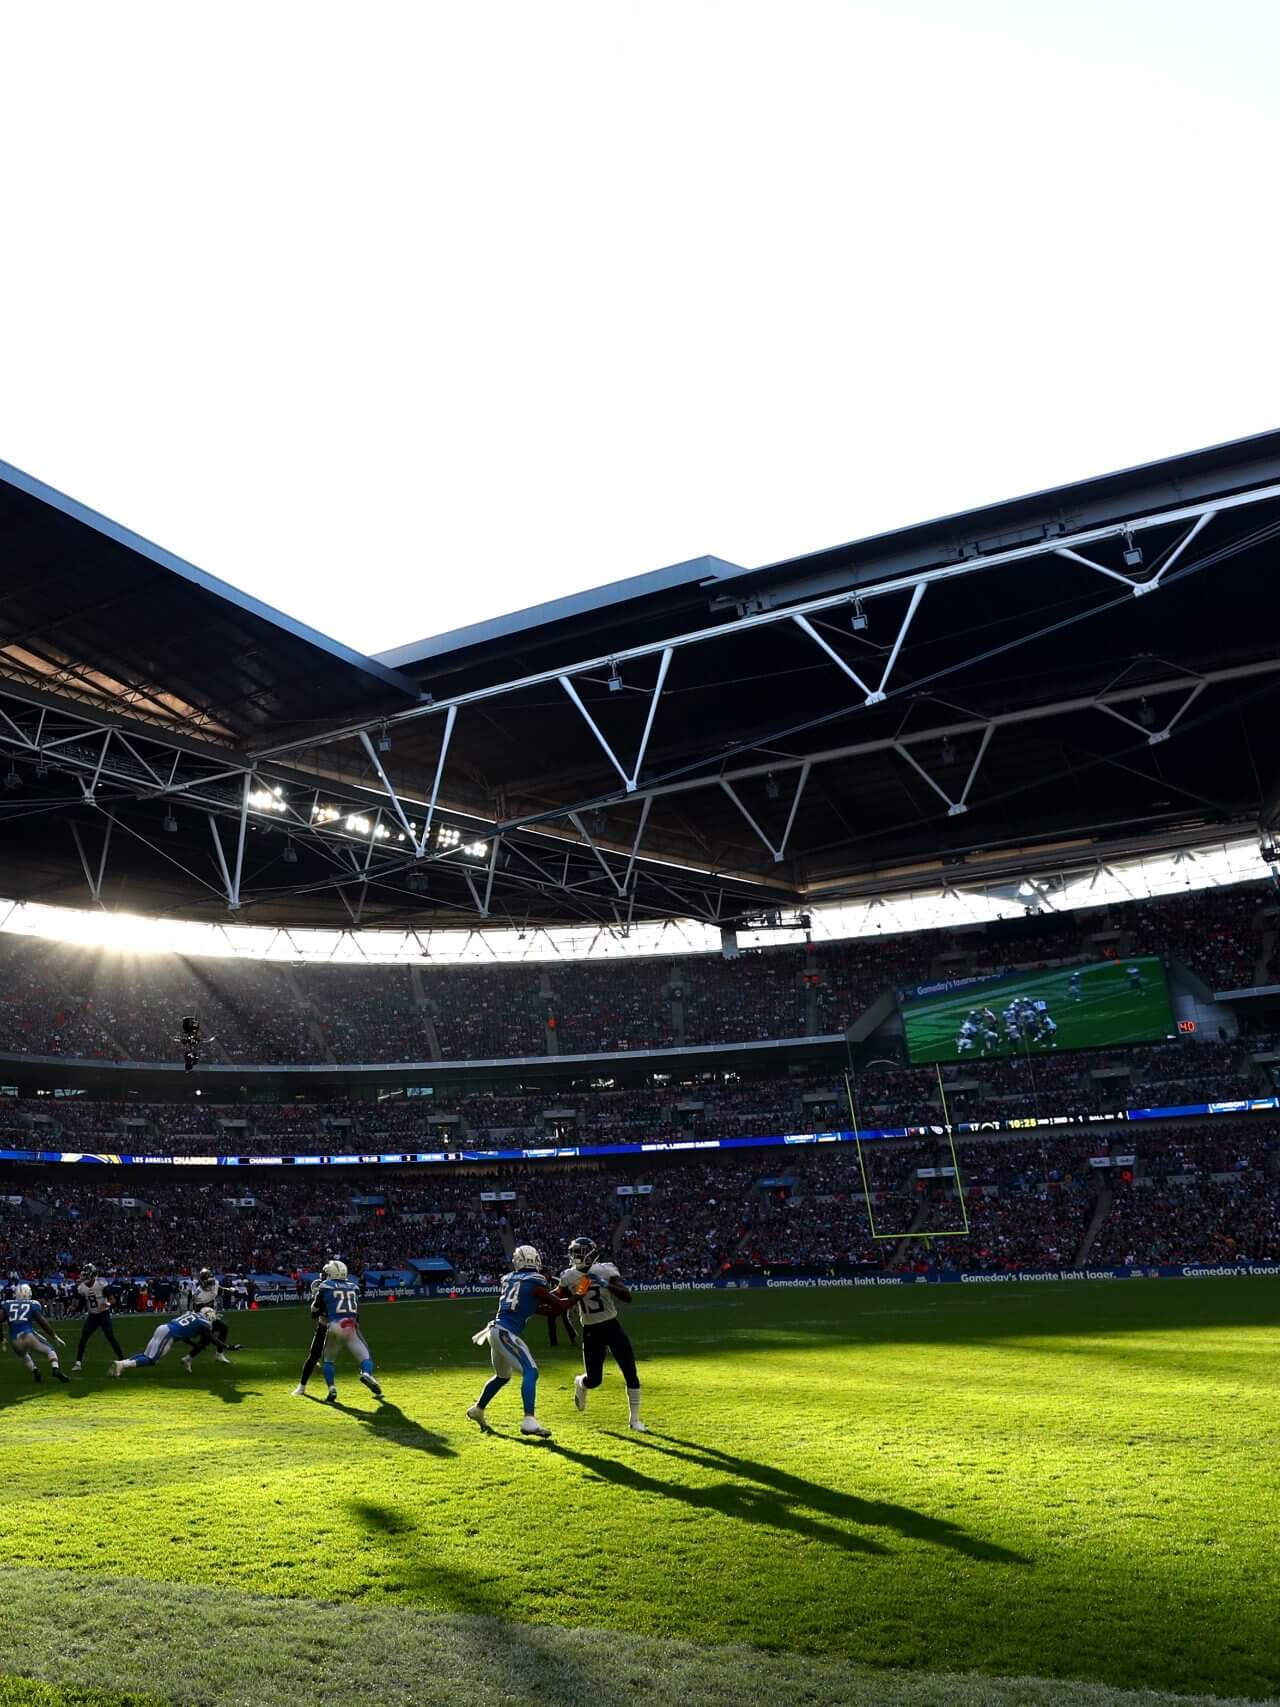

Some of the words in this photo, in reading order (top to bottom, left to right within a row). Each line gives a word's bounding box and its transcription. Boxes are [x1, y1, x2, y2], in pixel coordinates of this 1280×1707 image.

[1179, 1021, 1196, 1033] 40
[1008, 1118, 1037, 1128] 10:25
[132, 1156, 143, 1164] LOS
[960, 1272, 1017, 1283] Gameday's
[1019, 1271, 1058, 1282] favorite
[1060, 1270, 1085, 1281] light
[1086, 1269, 1117, 1281] lager.
[1182, 1266, 1247, 1277] Gameday's
[1249, 1264, 1280, 1275] favor
[639, 1282, 670, 1292] favorite
[672, 1280, 690, 1290] light
[766, 1277, 816, 1288] Gameday's
[818, 1276, 852, 1287] favorite
[854, 1275, 875, 1286] light
[877, 1275, 903, 1286] lager.
[472, 1284, 503, 1295] favorit
[333, 1290, 358, 1313] 20
[9, 1303, 31, 1321] 52
